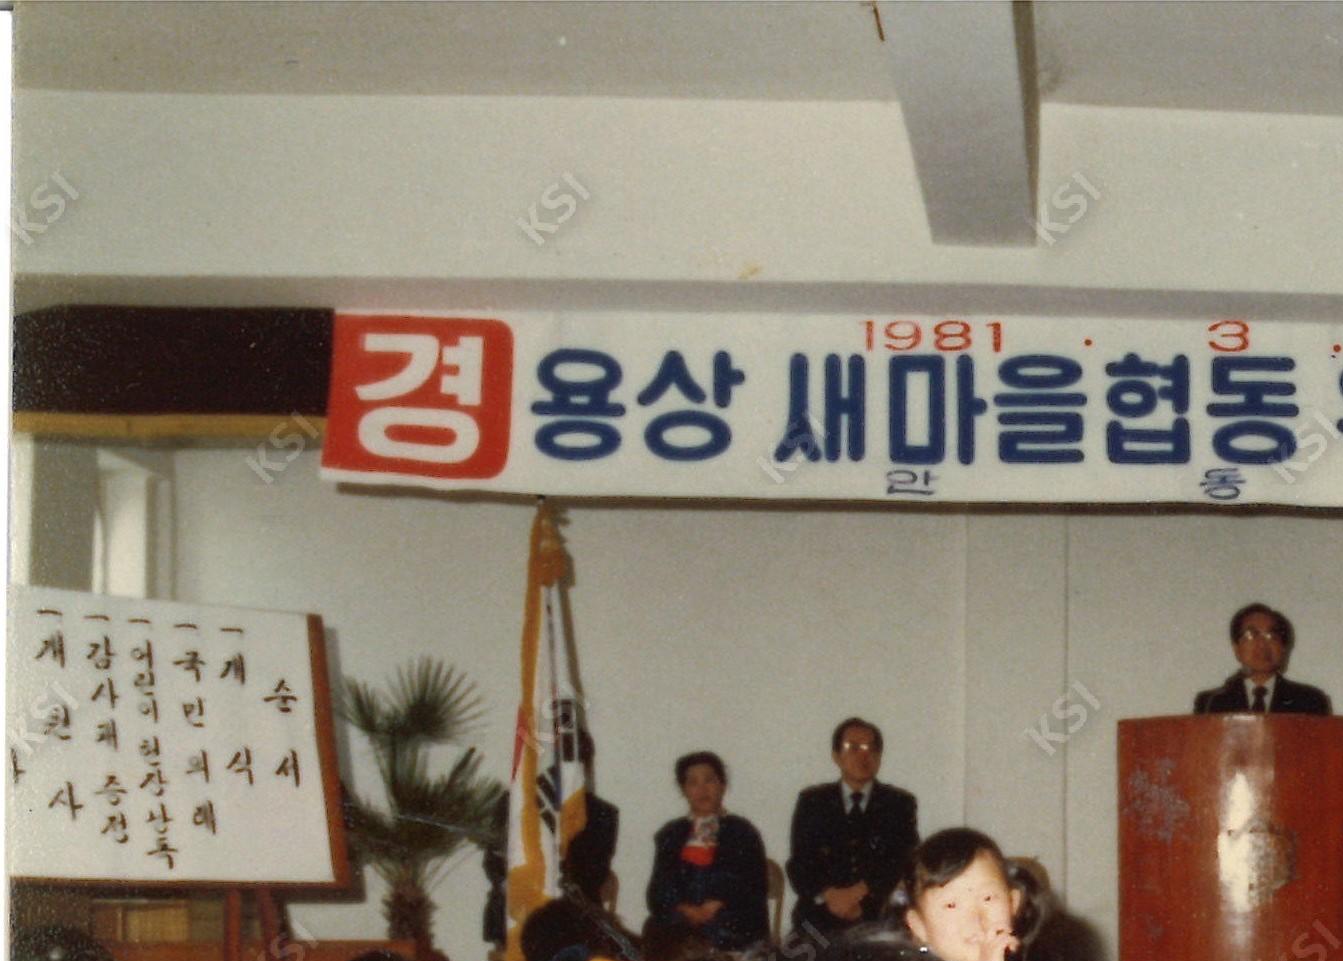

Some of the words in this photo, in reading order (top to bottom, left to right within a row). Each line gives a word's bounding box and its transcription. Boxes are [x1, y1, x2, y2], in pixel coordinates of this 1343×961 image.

[862, 318, 1005, 353] 1981
[1206, 318, 1251, 354] 3
[355, 332, 484, 465] 경
[531, 348, 746, 463] 용상
